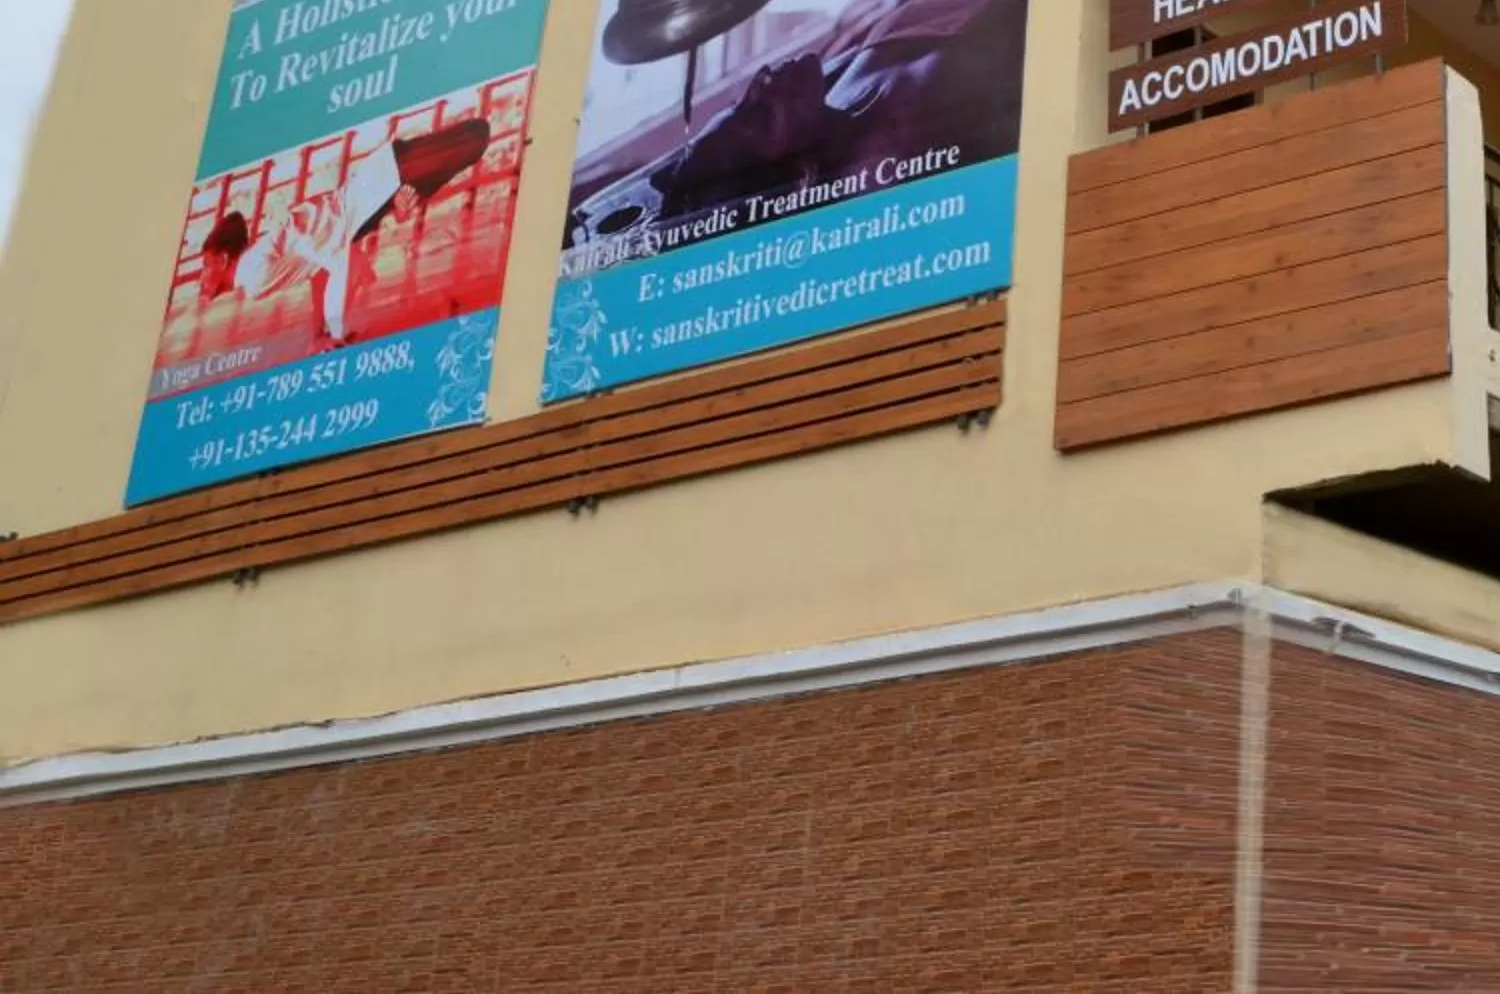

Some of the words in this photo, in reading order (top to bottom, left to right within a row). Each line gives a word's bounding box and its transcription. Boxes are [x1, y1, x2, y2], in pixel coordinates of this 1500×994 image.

[229, 67, 268, 111] To
[277, 8, 435, 95] Revitalize
[236, 18, 263, 60] A
[1117, 0, 1383, 116] ACCOMODATION
[326, 53, 398, 114] soul
[744, 162, 869, 224] Treatment
[875, 143, 962, 187] Centre
[638, 273, 666, 304] E:
[671, 192, 967, 294] sanskriti@kairali.com
[607, 329, 646, 360] W:
[650, 238, 992, 351] sanskritivedicretreat.com
[159, 362, 200, 391] Yoga
[203, 345, 263, 377] Centre
[175, 396, 215, 431] Tel:
[219, 369, 303, 414] +91-789
[307, 357, 347, 394] 551
[188, 413, 317, 470] +91-135-244
[320, 397, 380, 438] 2999
